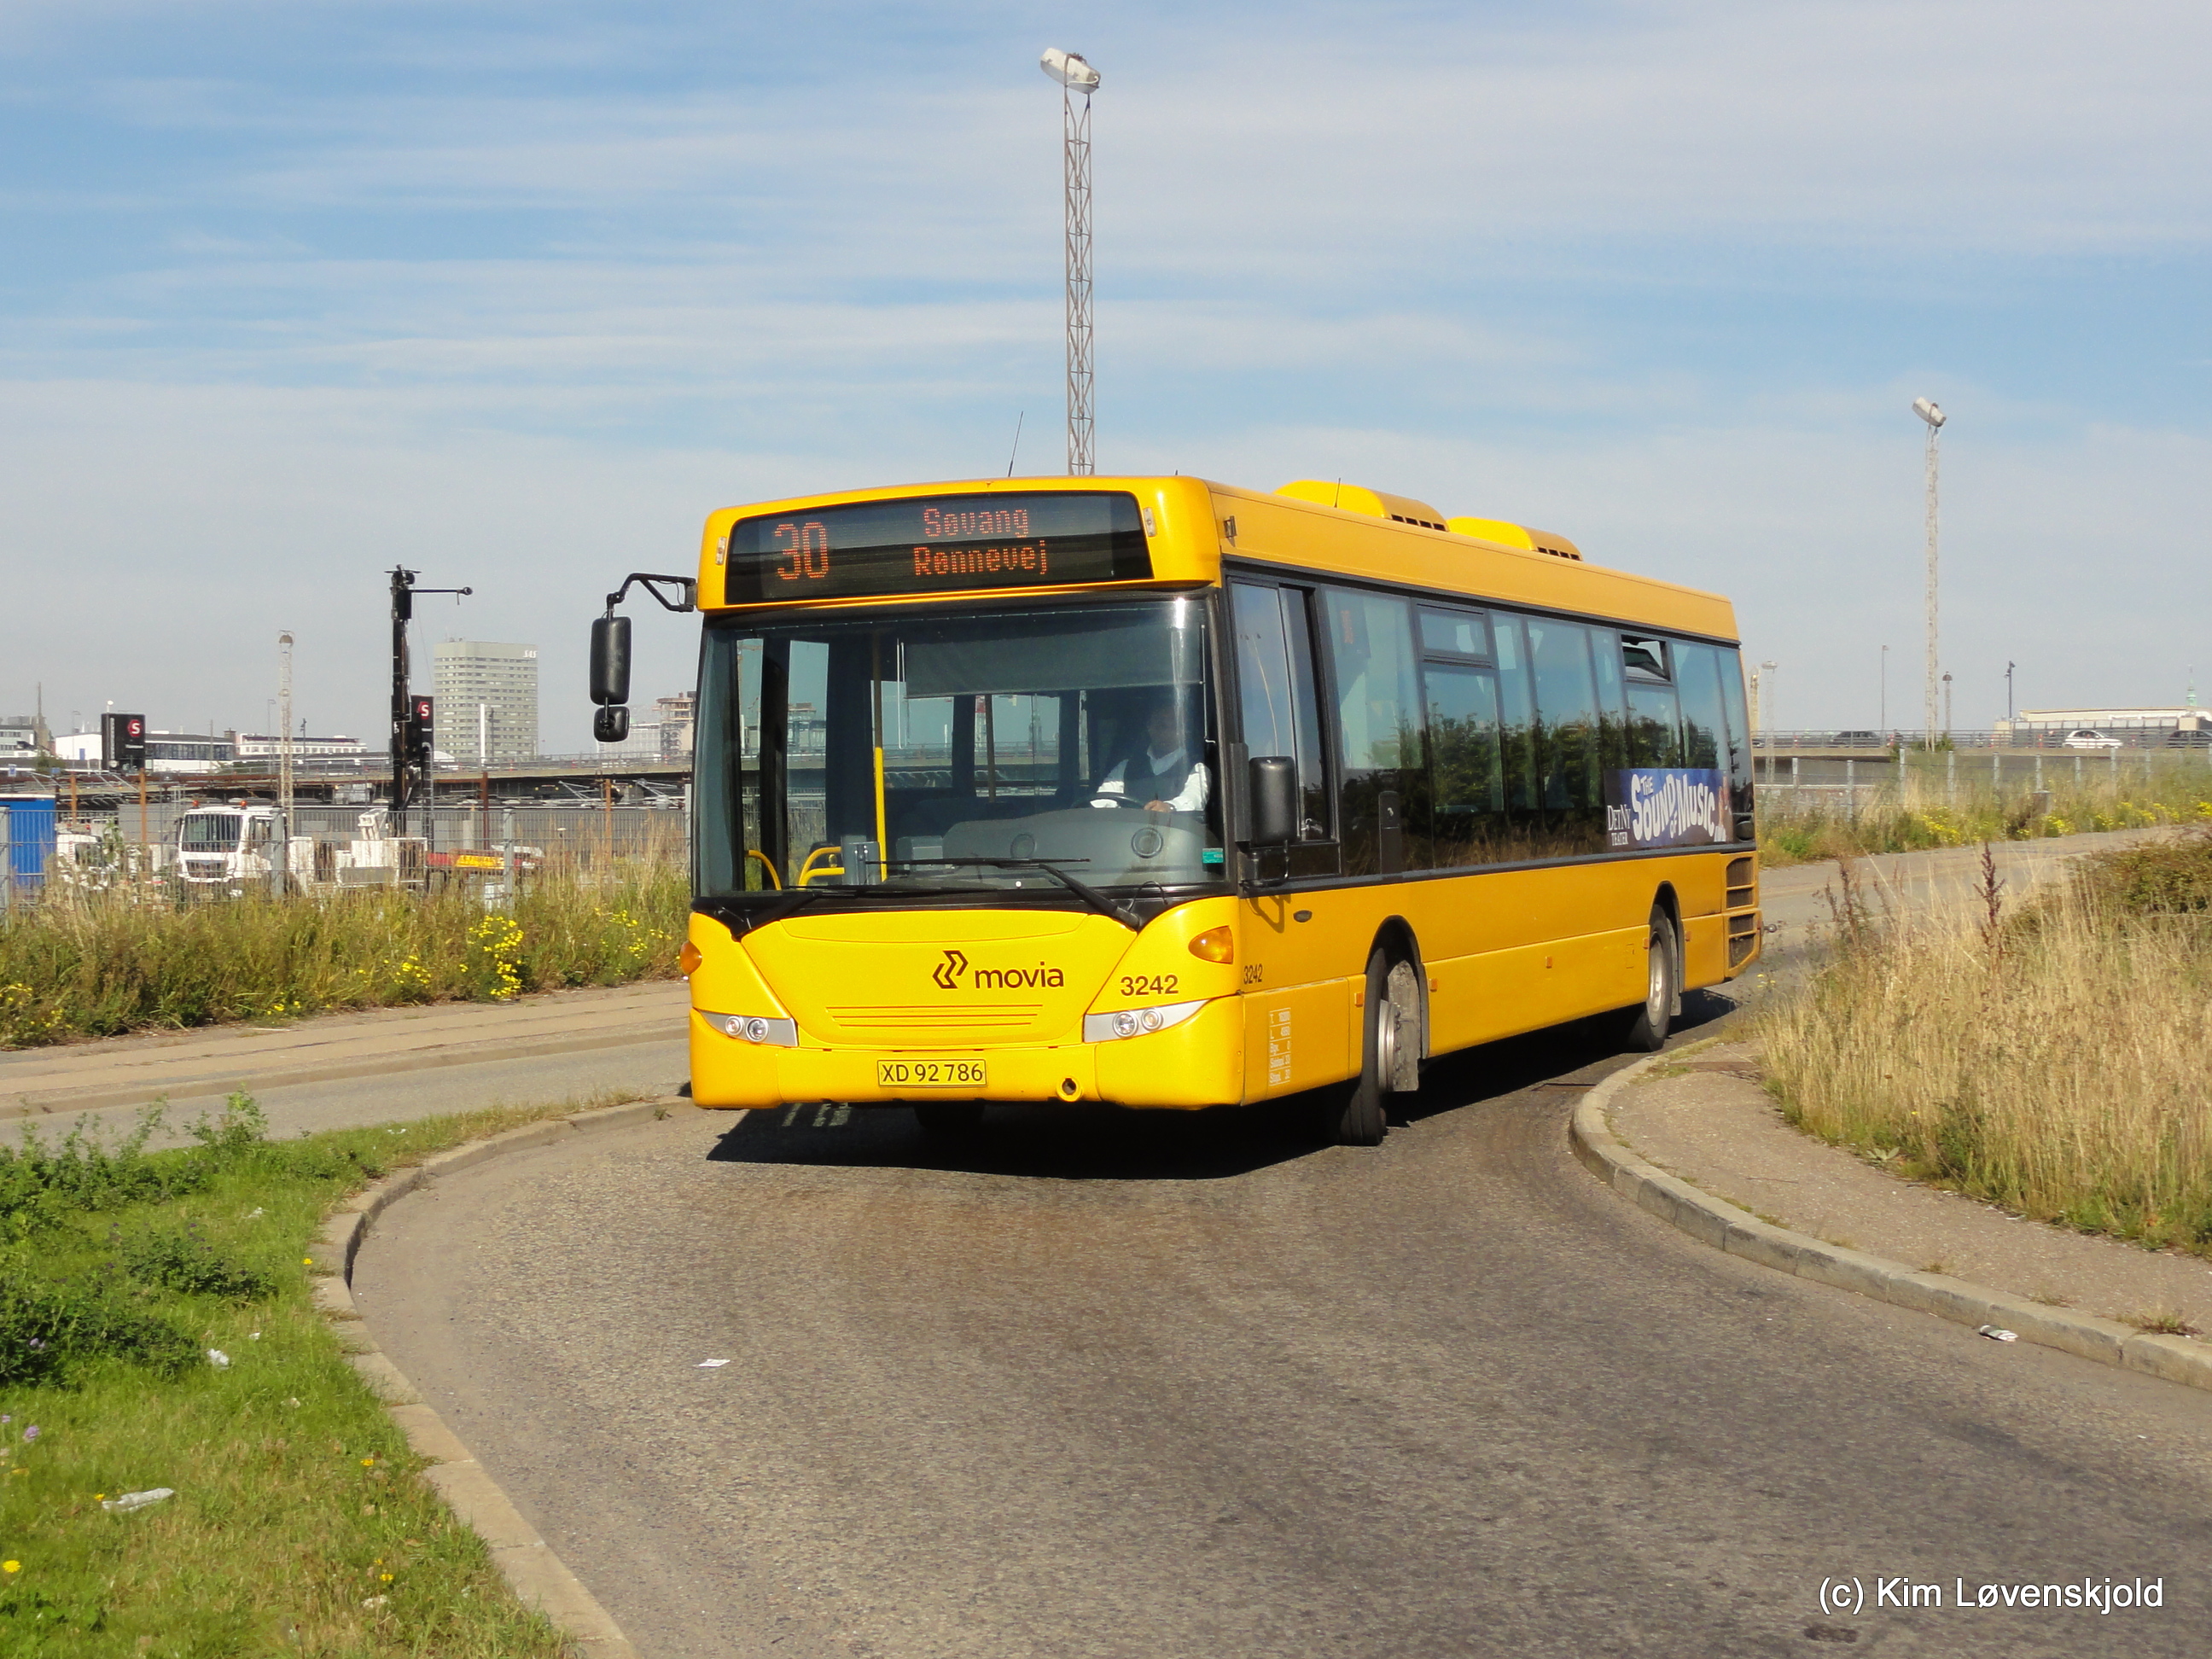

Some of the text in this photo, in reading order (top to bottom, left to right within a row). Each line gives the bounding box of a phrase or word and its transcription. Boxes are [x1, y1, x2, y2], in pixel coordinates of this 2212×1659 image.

[773, 521, 830, 579] 30
[421, 704, 429, 717] S
[131, 722, 141, 735] S
[974, 961, 1065, 989] movia
[1243, 963, 1263, 984] 3242
[1120, 974, 1179, 997] 3242
[882, 1062, 983, 1082] XD 92 786
